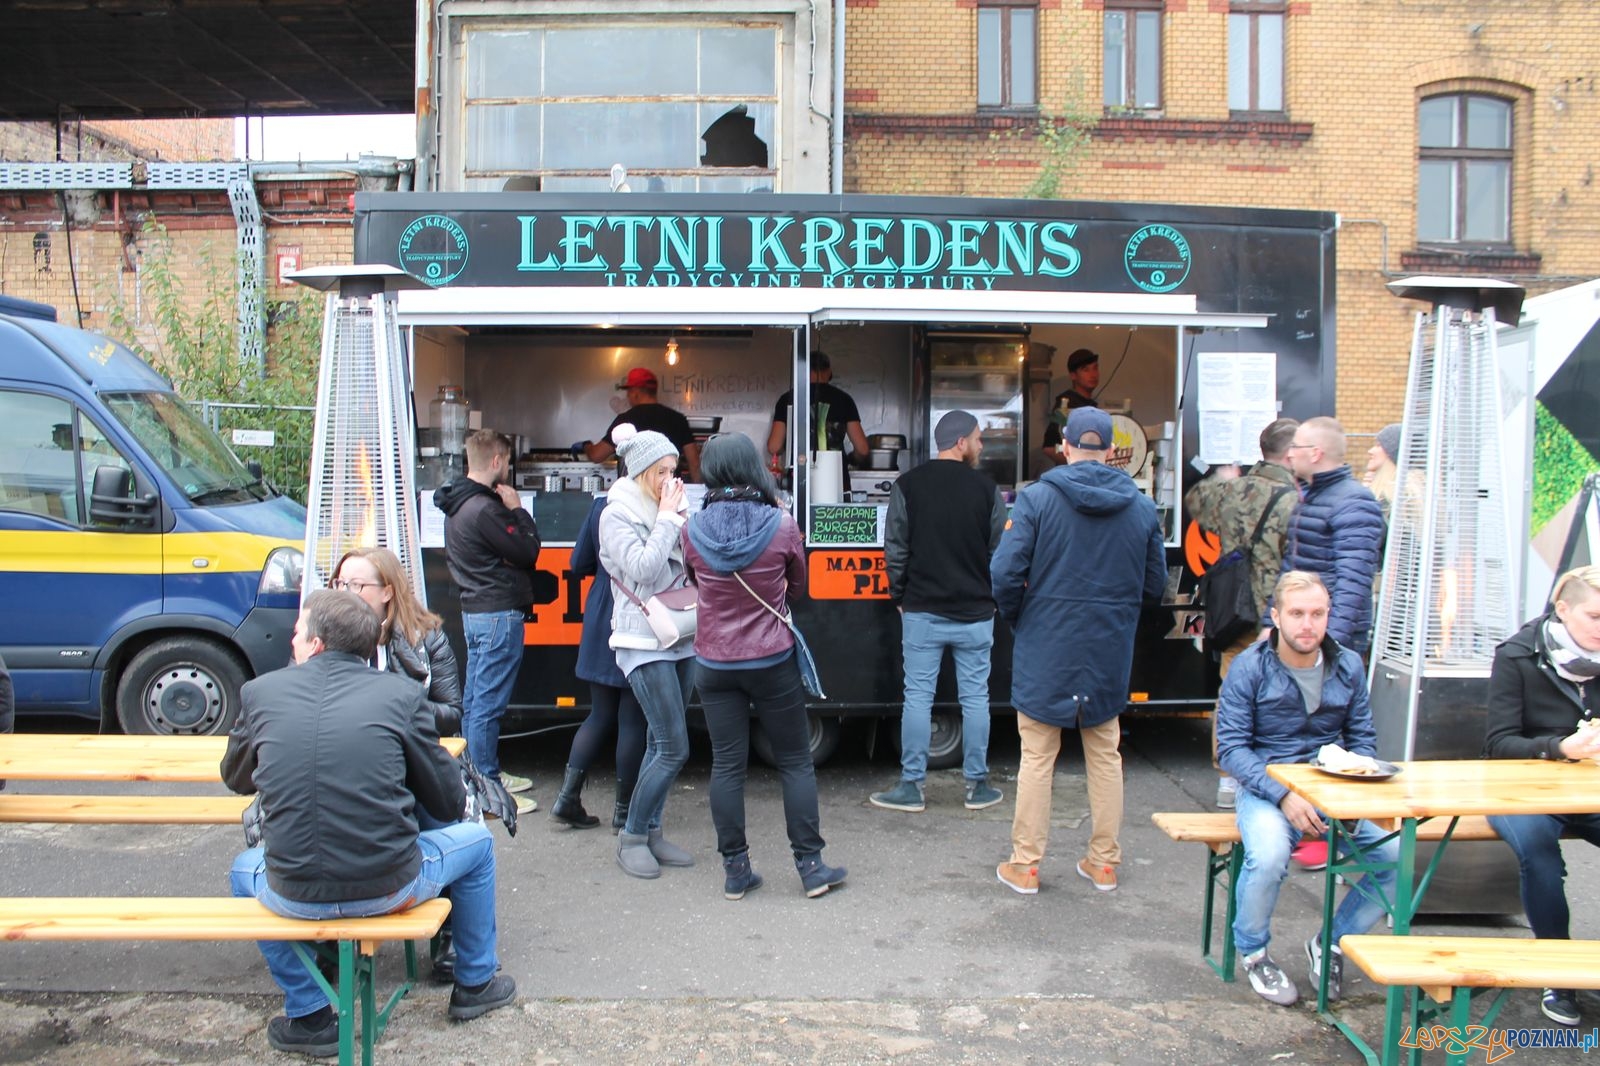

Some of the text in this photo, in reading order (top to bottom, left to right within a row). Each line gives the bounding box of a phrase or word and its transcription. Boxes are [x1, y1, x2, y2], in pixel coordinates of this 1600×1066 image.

[402, 217, 466, 249] LETNI KREDENS
[1128, 226, 1188, 258] LETNI KREDENS
[516, 215, 1081, 278] LETNI KREDENS
[605, 272, 995, 290] TRADYCYJNE RECEPTURY
[815, 507, 877, 519] SZARPANE
[814, 521, 877, 534] BURGERY
[826, 557, 886, 571] MADE
